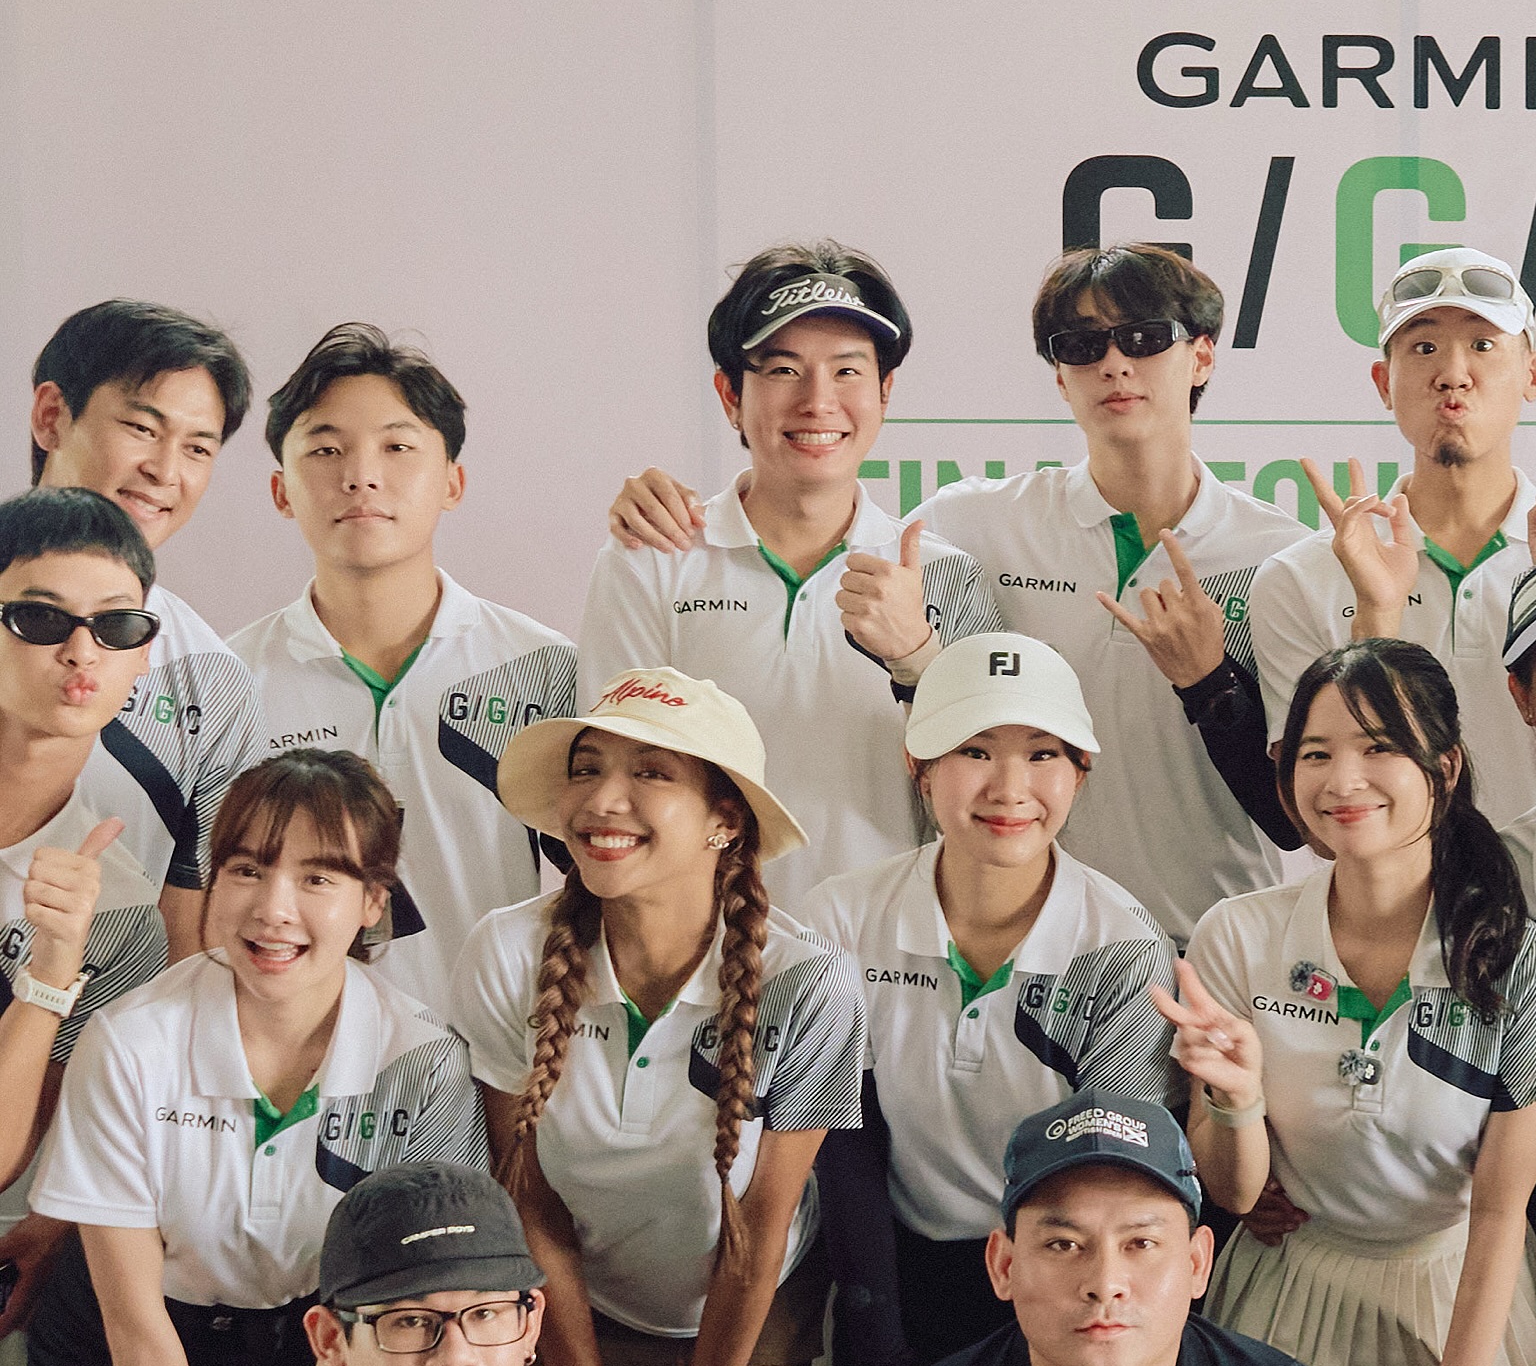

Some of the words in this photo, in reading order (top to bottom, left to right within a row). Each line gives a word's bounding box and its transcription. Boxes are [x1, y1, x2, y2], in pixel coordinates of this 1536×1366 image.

[999, 573, 1077, 593] GARMIN
[673, 598, 748, 615] GARMIN
[989, 651, 1021, 676] FJ
[269, 725, 338, 750] ARMIN
[865, 967, 938, 990] GARMIN
[1252, 995, 1340, 1026] GARMIN
[527, 1014, 610, 1042] GMIN
[155, 1106, 237, 1133] GARMIN
[1067, 1108, 1105, 1128] FREED
[1106, 1110, 1147, 1131] GROUP
